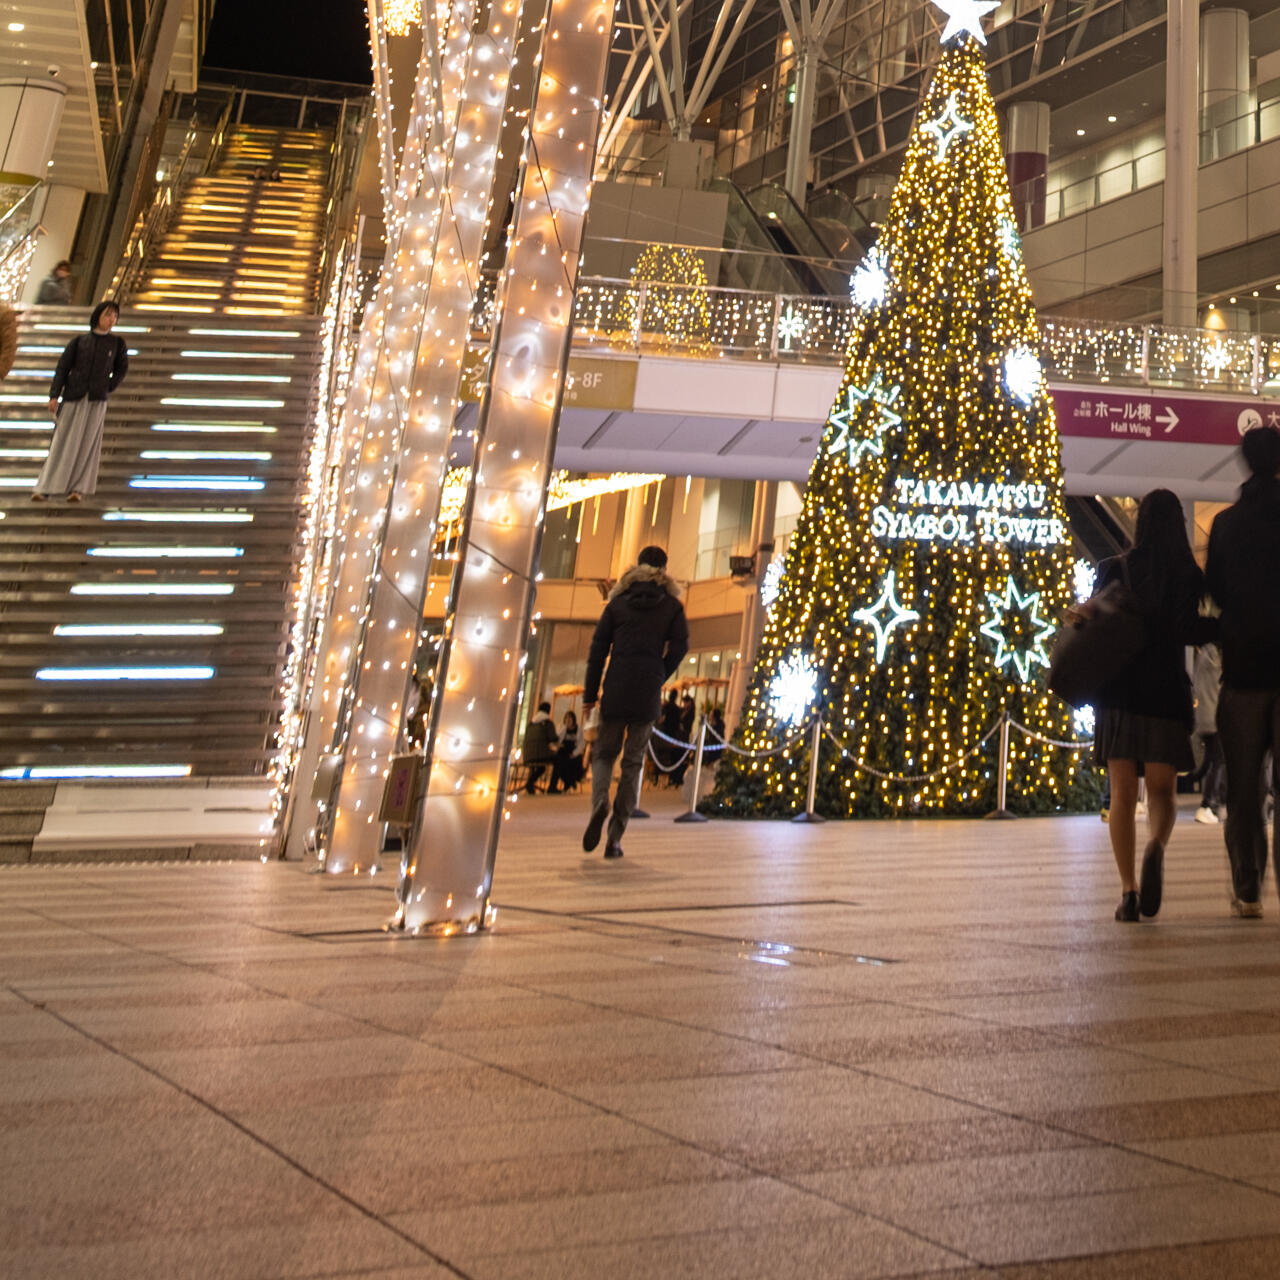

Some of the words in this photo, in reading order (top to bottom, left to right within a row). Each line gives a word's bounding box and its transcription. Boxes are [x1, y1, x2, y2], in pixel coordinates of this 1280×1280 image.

[1094, 400, 1152, 421] ホール棟
[1110, 421, 1128, 433] Hall
[1128, 422, 1152, 438] Wing
[895, 478, 1047, 509] TAKAMATSU
[871, 505, 975, 540] SYMBOL
[976, 509, 1065, 546] TOWER
